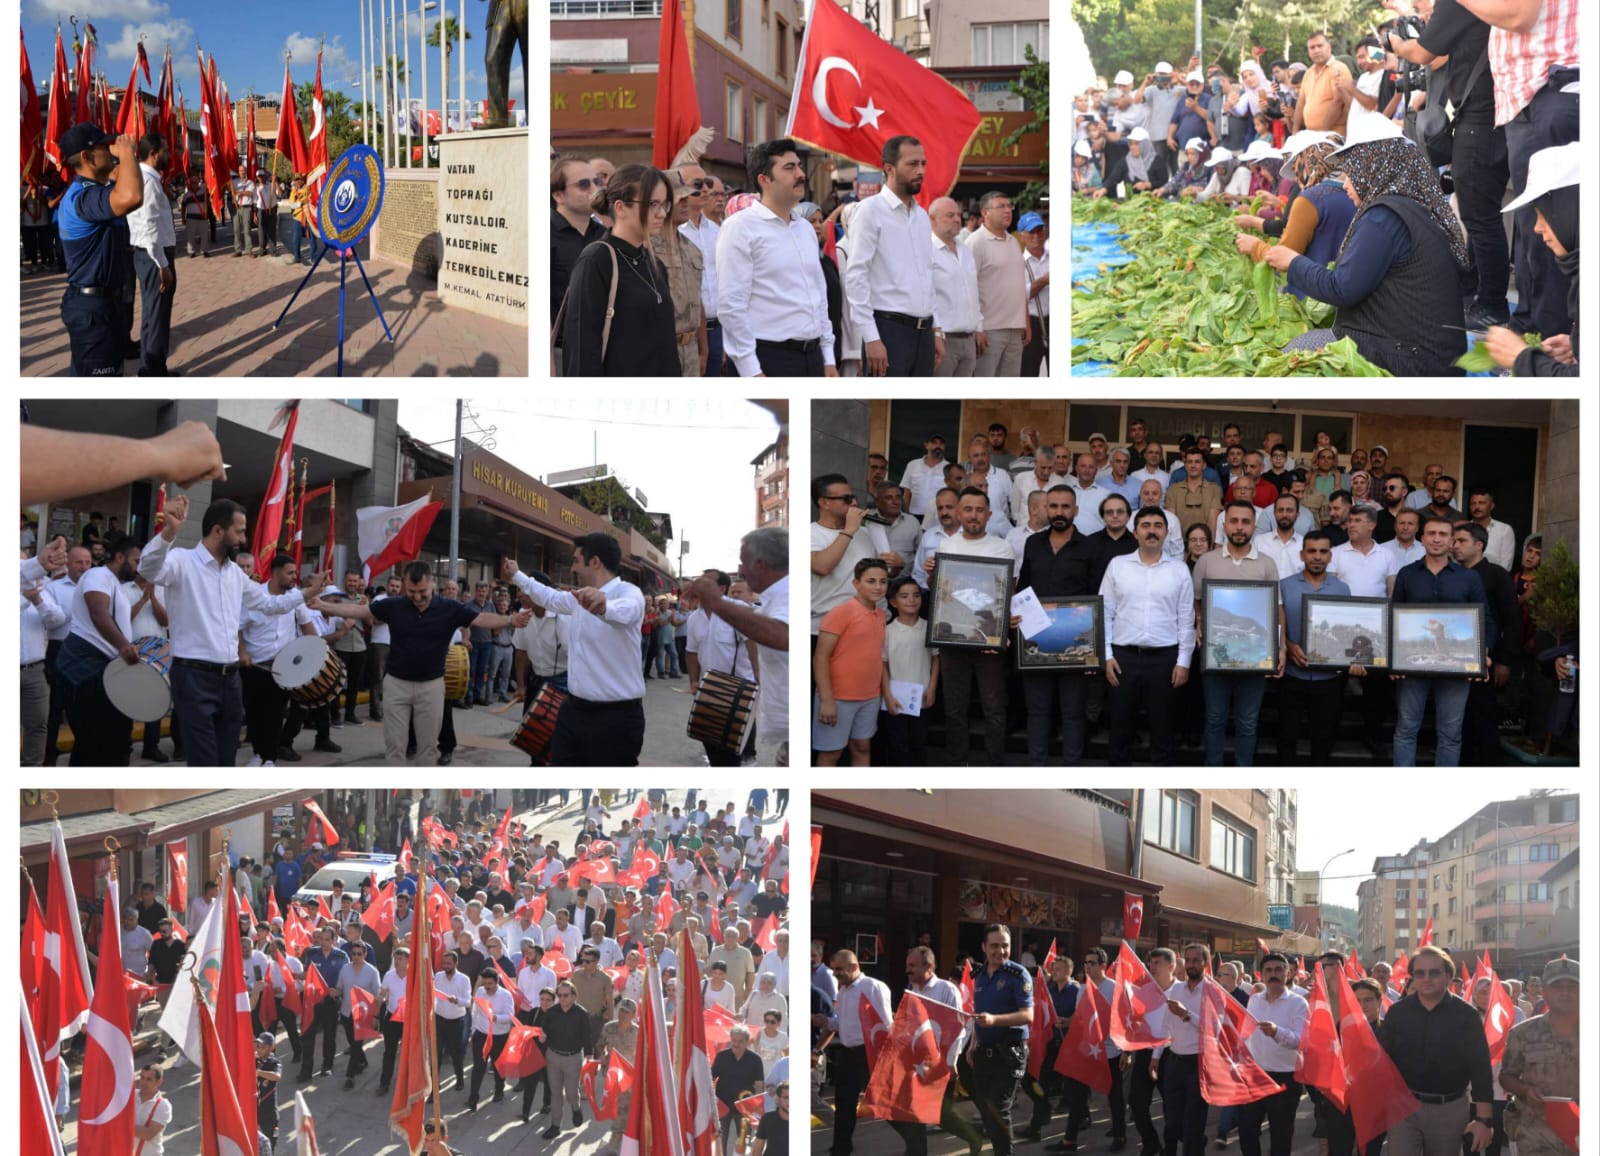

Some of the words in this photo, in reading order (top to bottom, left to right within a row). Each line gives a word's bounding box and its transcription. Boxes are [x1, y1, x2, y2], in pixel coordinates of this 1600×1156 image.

[580, 86, 637, 114] ÇEYİZ
[447, 164, 475, 175] VATAN
[446, 188, 493, 201] TOPRAĞI
[446, 213, 508, 230] KUTSALDIR.
[446, 237, 498, 254] KADERİNE
[445, 260, 529, 288] TERKEDİLEMEZ
[485, 291, 526, 310] ATATÜRK
